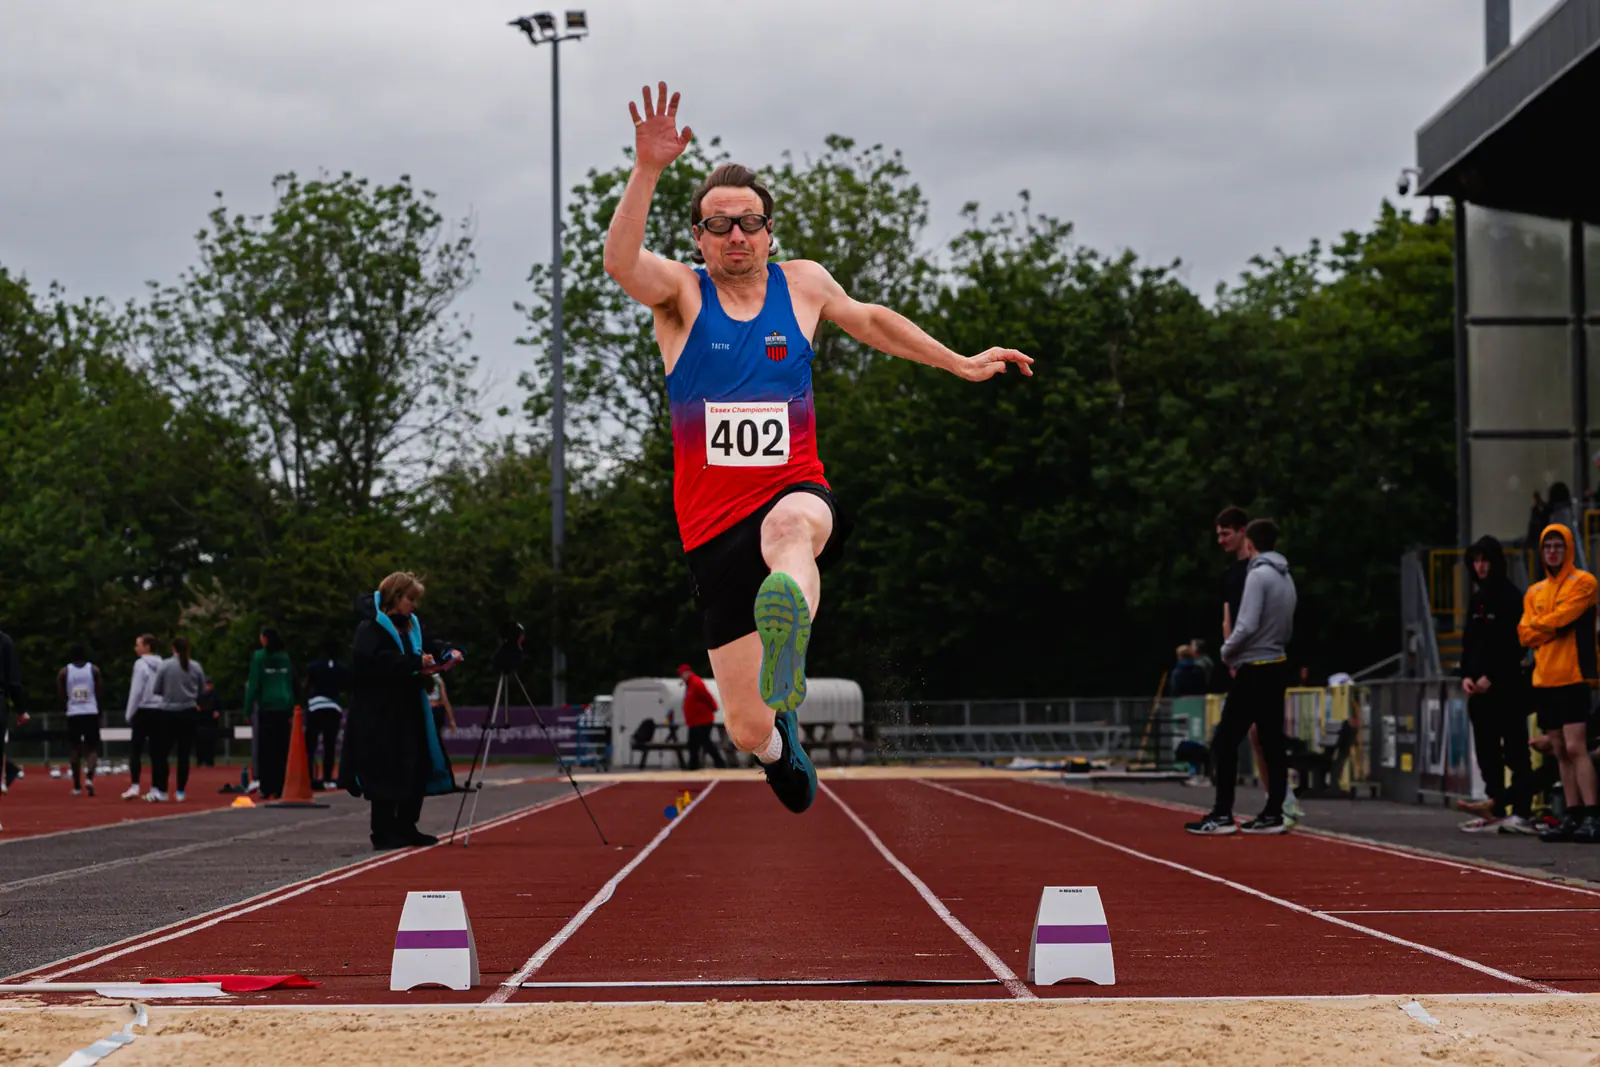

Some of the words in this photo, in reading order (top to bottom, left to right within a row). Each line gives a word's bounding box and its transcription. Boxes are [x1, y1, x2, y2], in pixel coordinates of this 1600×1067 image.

[711, 342, 730, 350] TACTIC
[709, 406, 730, 414] Essex
[731, 406, 784, 414] Championships
[711, 419, 784, 457] 402
